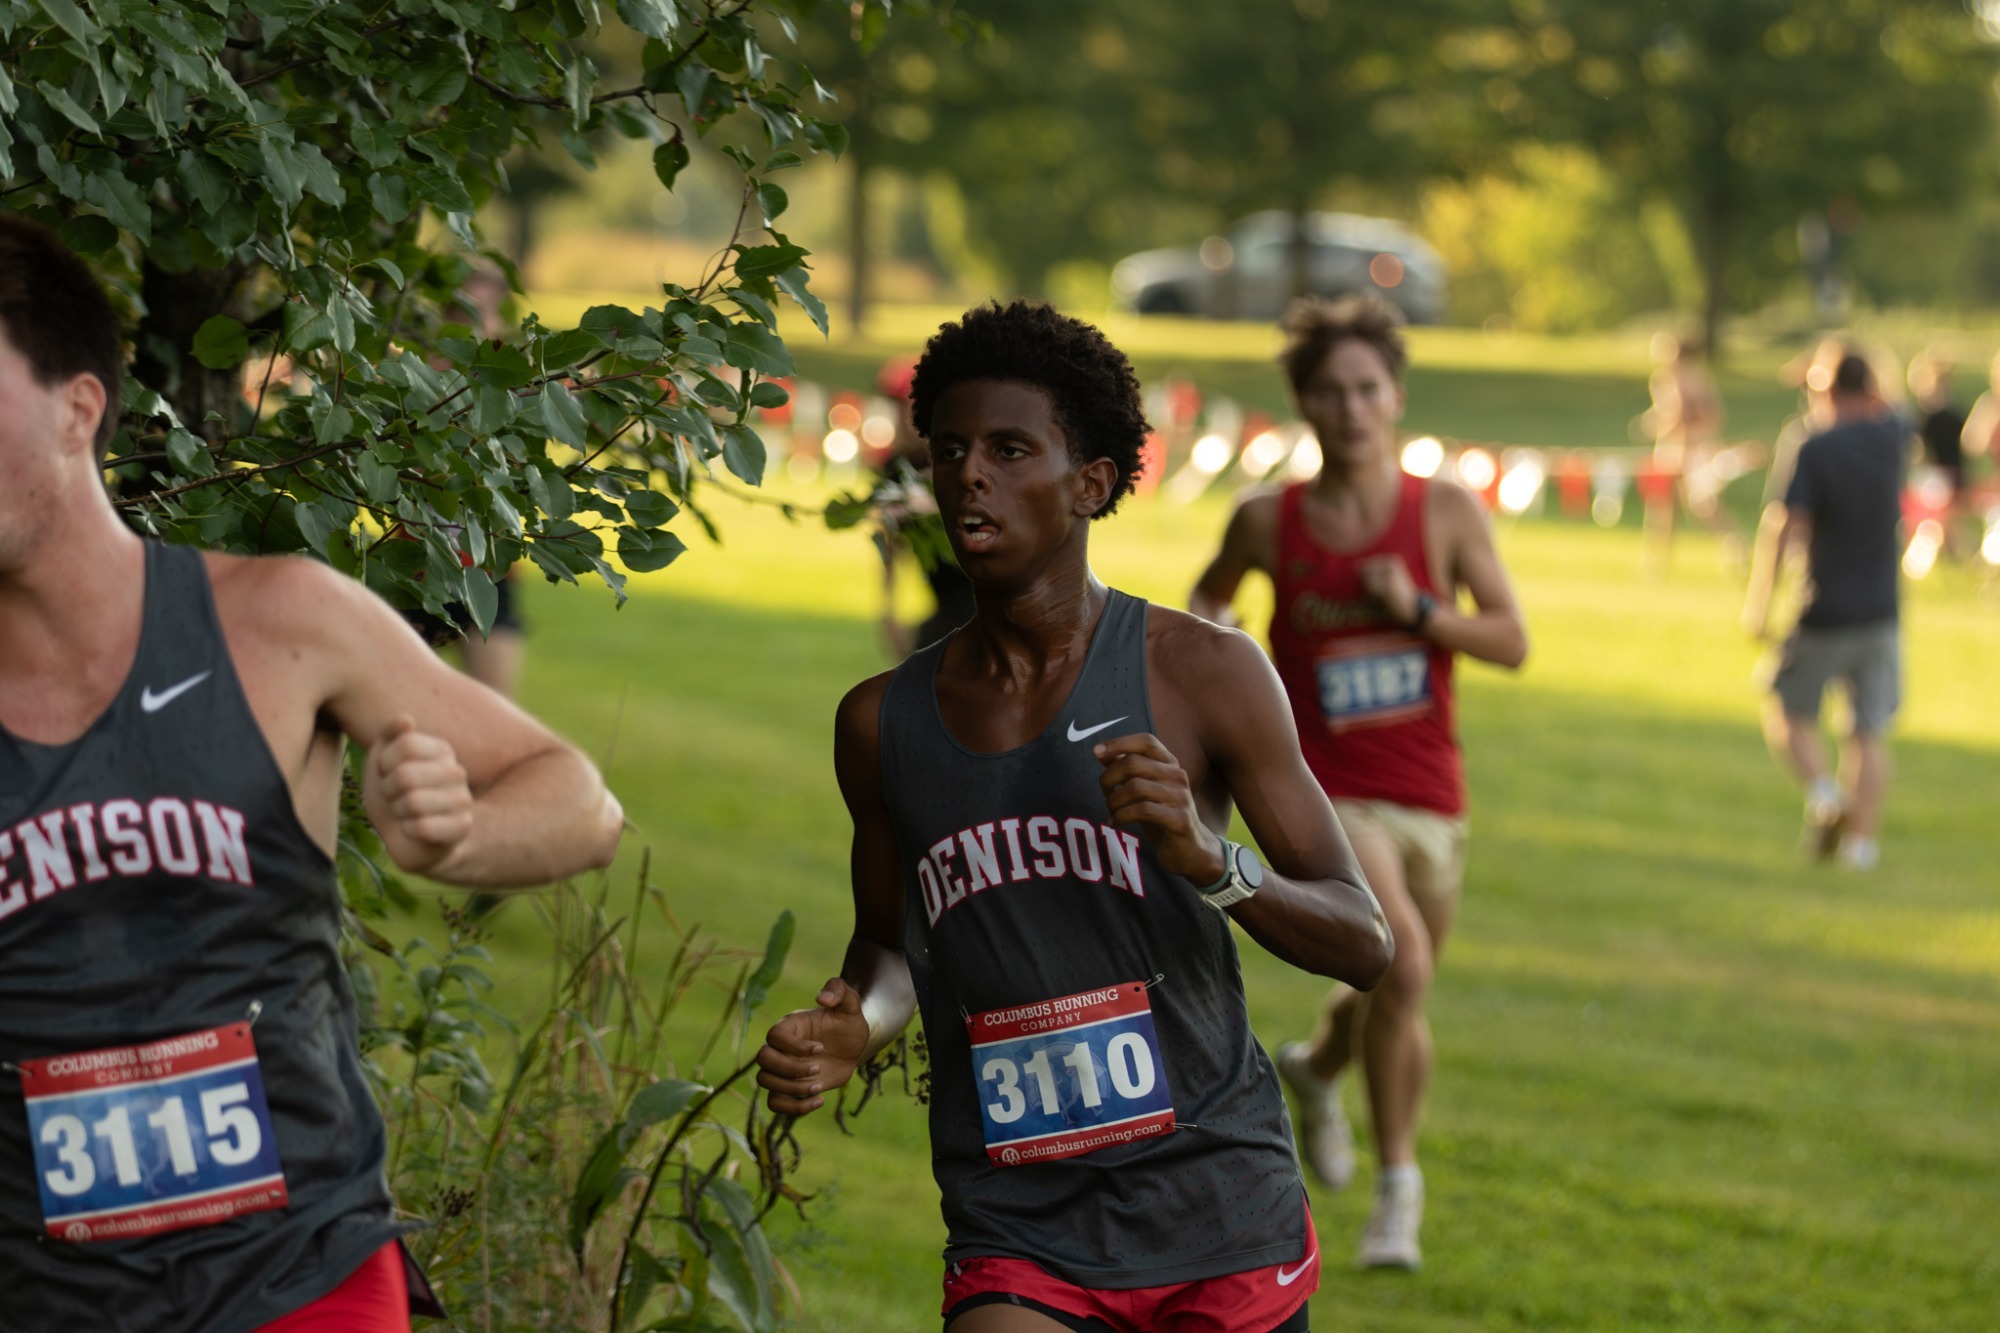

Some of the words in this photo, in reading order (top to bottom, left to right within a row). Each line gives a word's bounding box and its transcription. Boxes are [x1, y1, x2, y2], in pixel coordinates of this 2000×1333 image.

[0, 797, 254, 920] ENISON
[917, 816, 1145, 928] DENISON
[984, 1003, 1051, 1026] COLUMBUS
[1053, 989, 1119, 1013] RUNNING
[1020, 1012, 1081, 1032] COMPANY
[47, 1049, 137, 1076] COLUMBUS
[138, 1031, 219, 1061] RUNNING
[95, 1061, 173, 1084] COMPANY
[982, 1032, 1156, 1124] 3110
[39, 1082, 262, 1196] 3115
[1022, 1123, 1161, 1158] columbusrunning.com
[92, 1192, 270, 1236] columbusrunning.com
